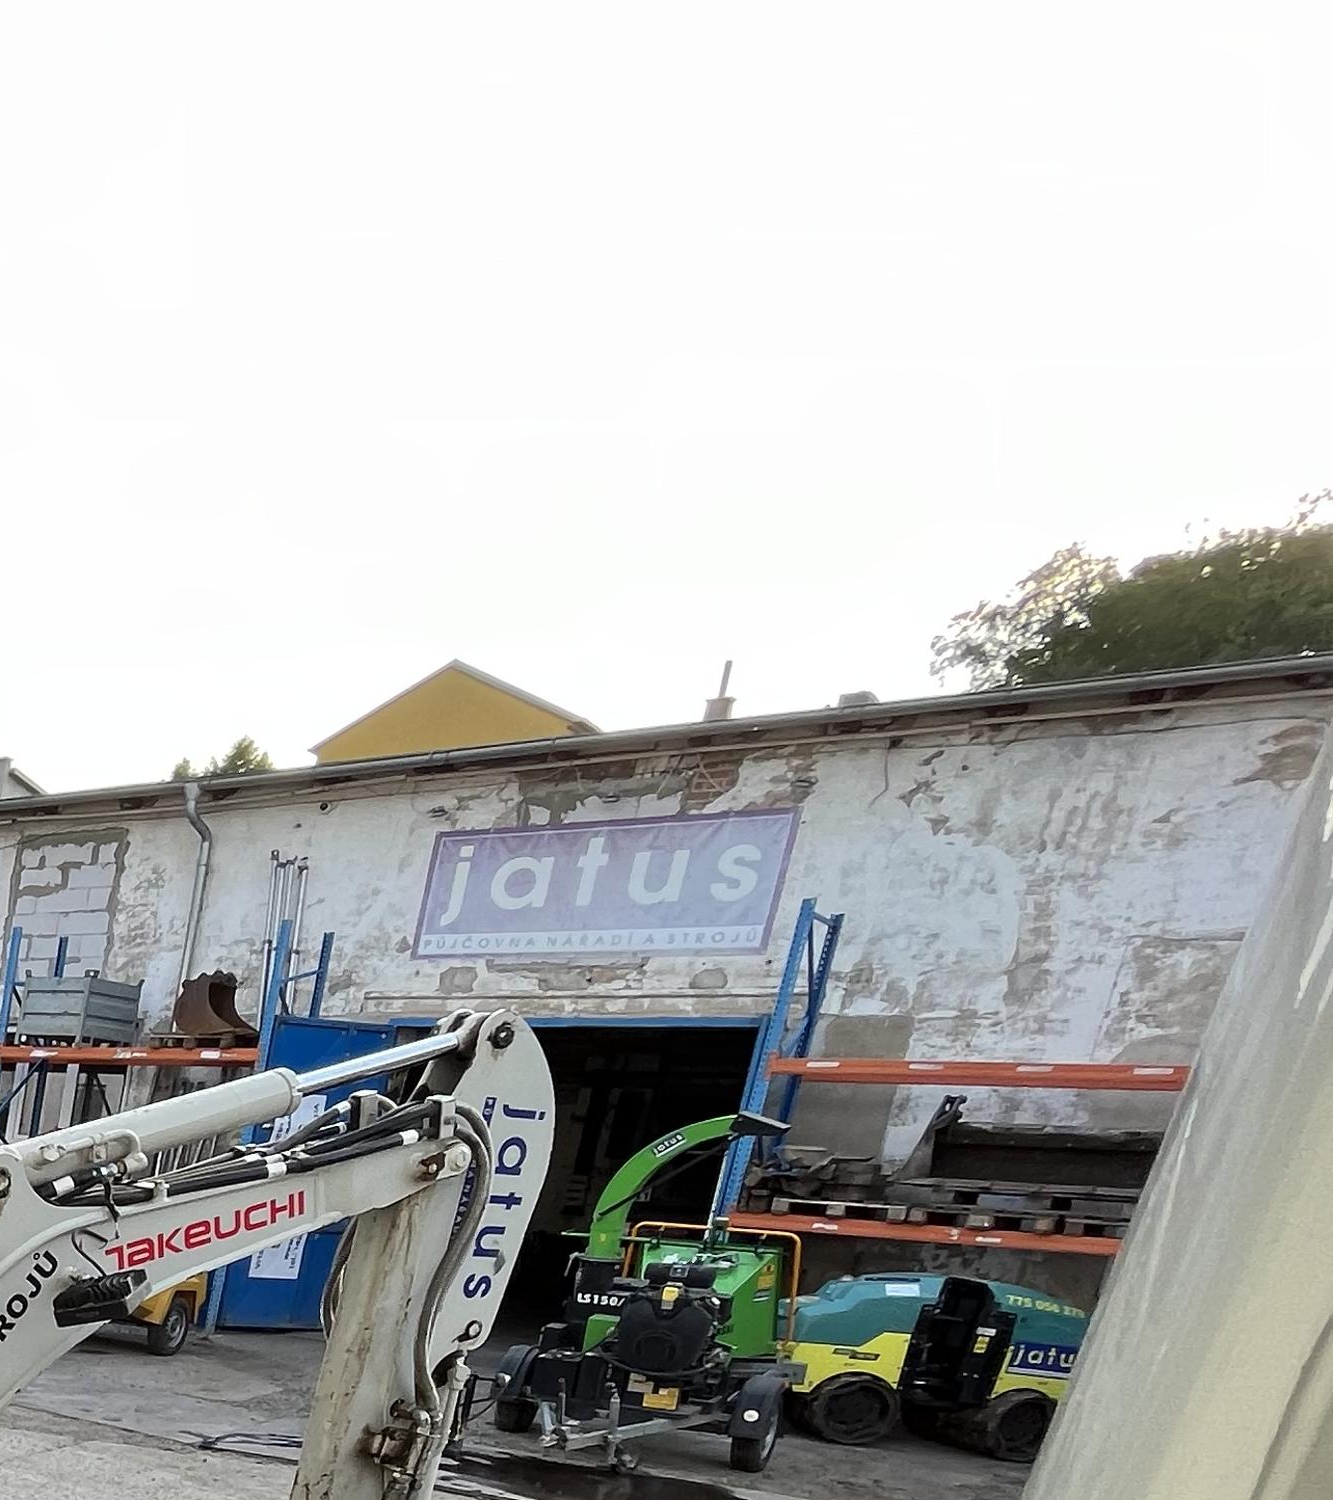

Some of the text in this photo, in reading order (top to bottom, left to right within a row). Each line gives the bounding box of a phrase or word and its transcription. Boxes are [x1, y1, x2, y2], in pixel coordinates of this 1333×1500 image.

[440, 837, 763, 927] jatus
[423, 935, 536, 950] PŮJČOVNA
[643, 934, 655, 945] A
[667, 927, 758, 945] STROJŮ
[463, 1104, 546, 1298] jatus
